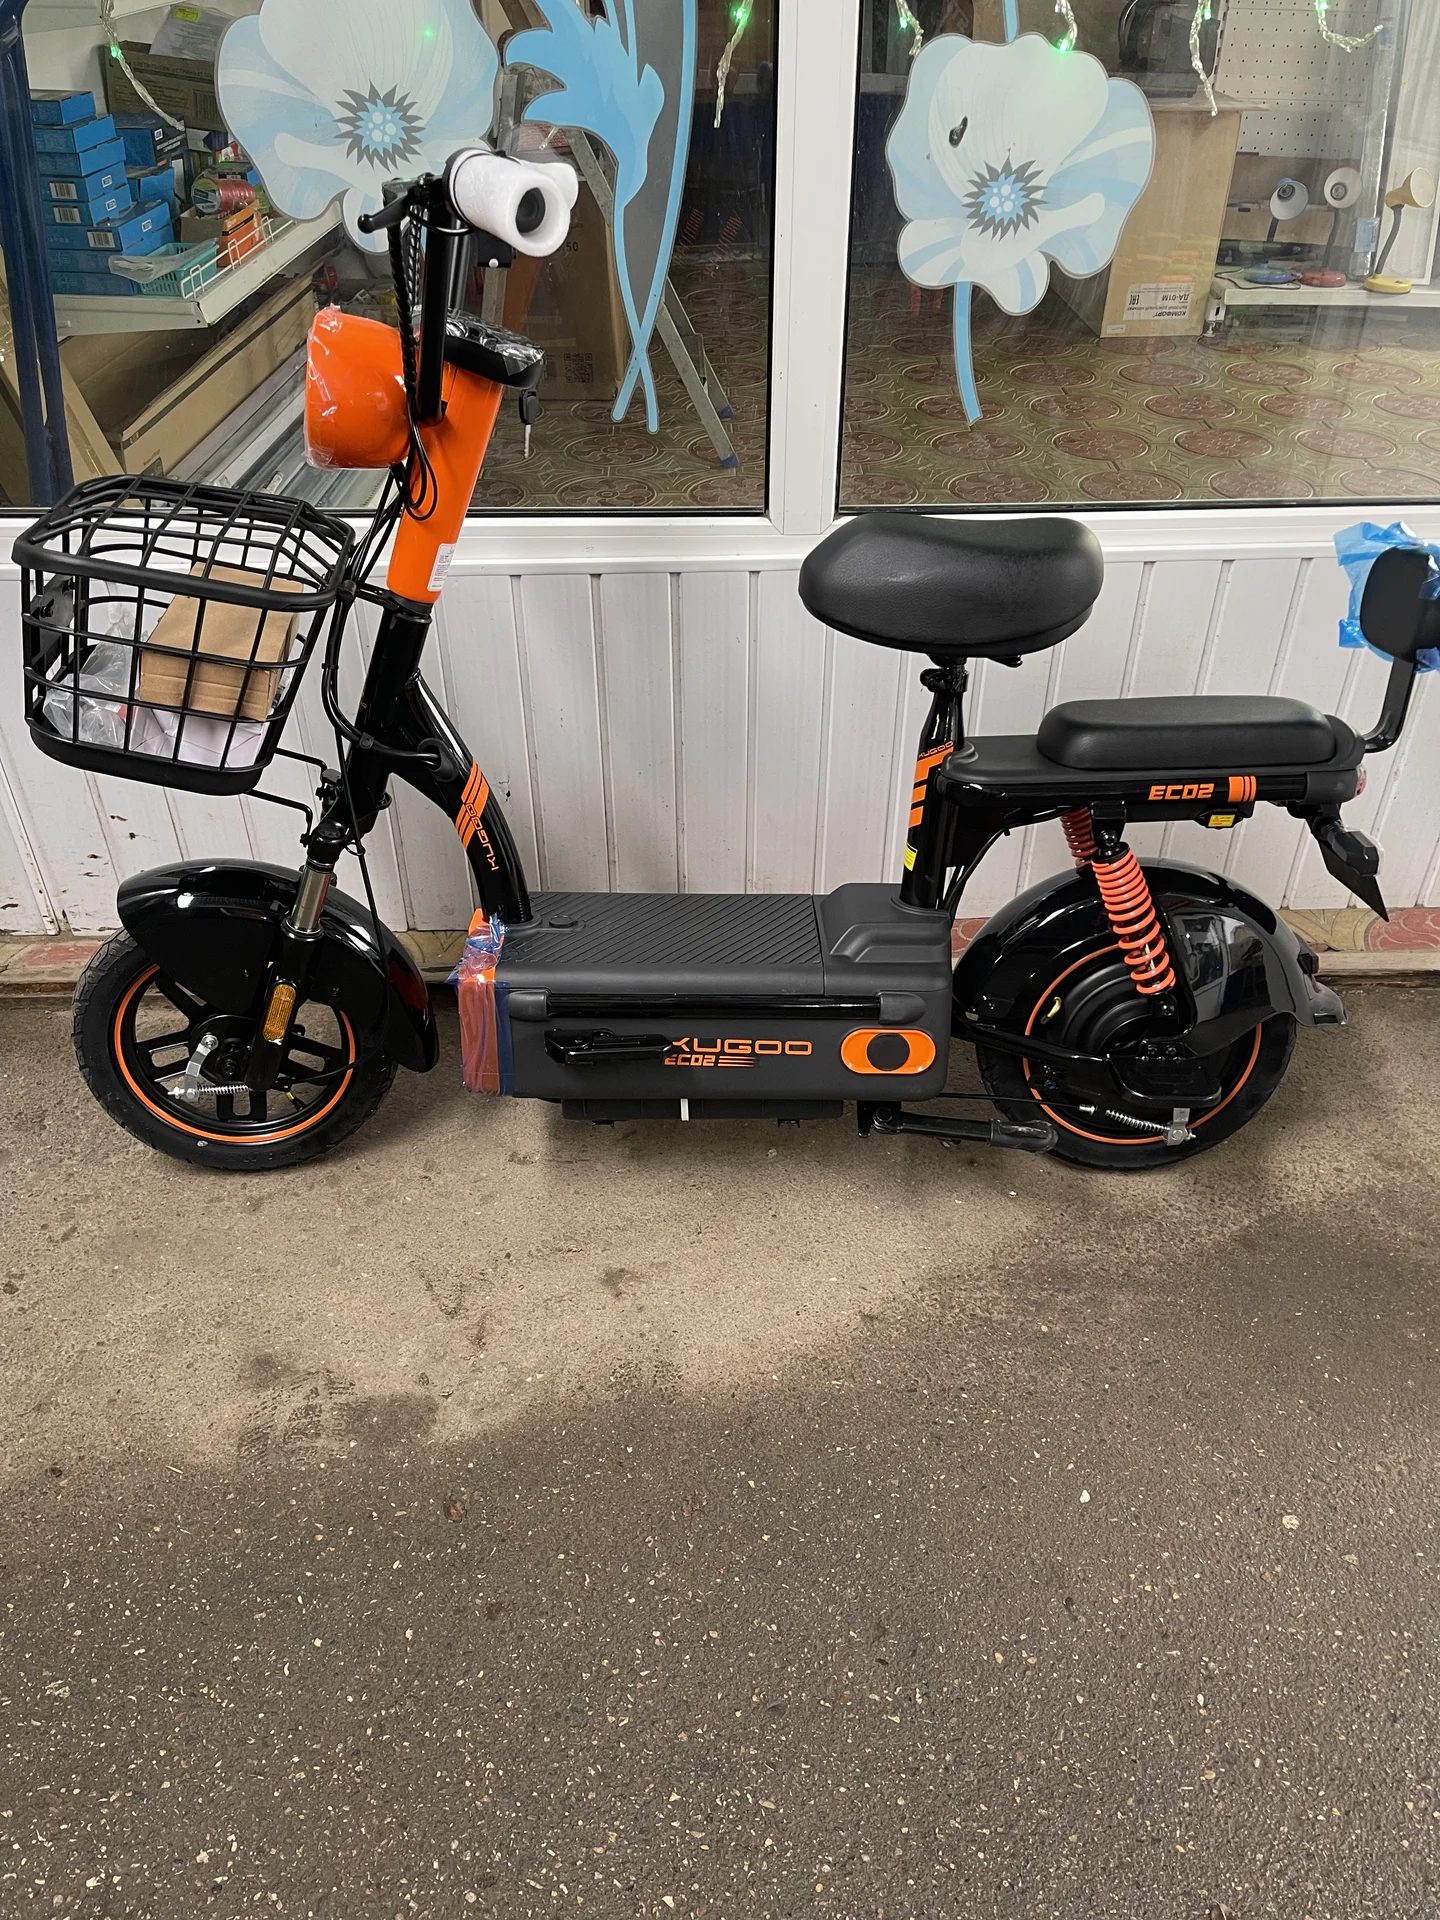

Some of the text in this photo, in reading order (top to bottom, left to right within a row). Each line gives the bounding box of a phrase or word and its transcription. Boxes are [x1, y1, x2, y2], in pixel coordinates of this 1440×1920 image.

[918, 740, 954, 759] KUGOO
[1148, 783, 1215, 801] ECO2
[464, 802, 500, 871] KUGOO
